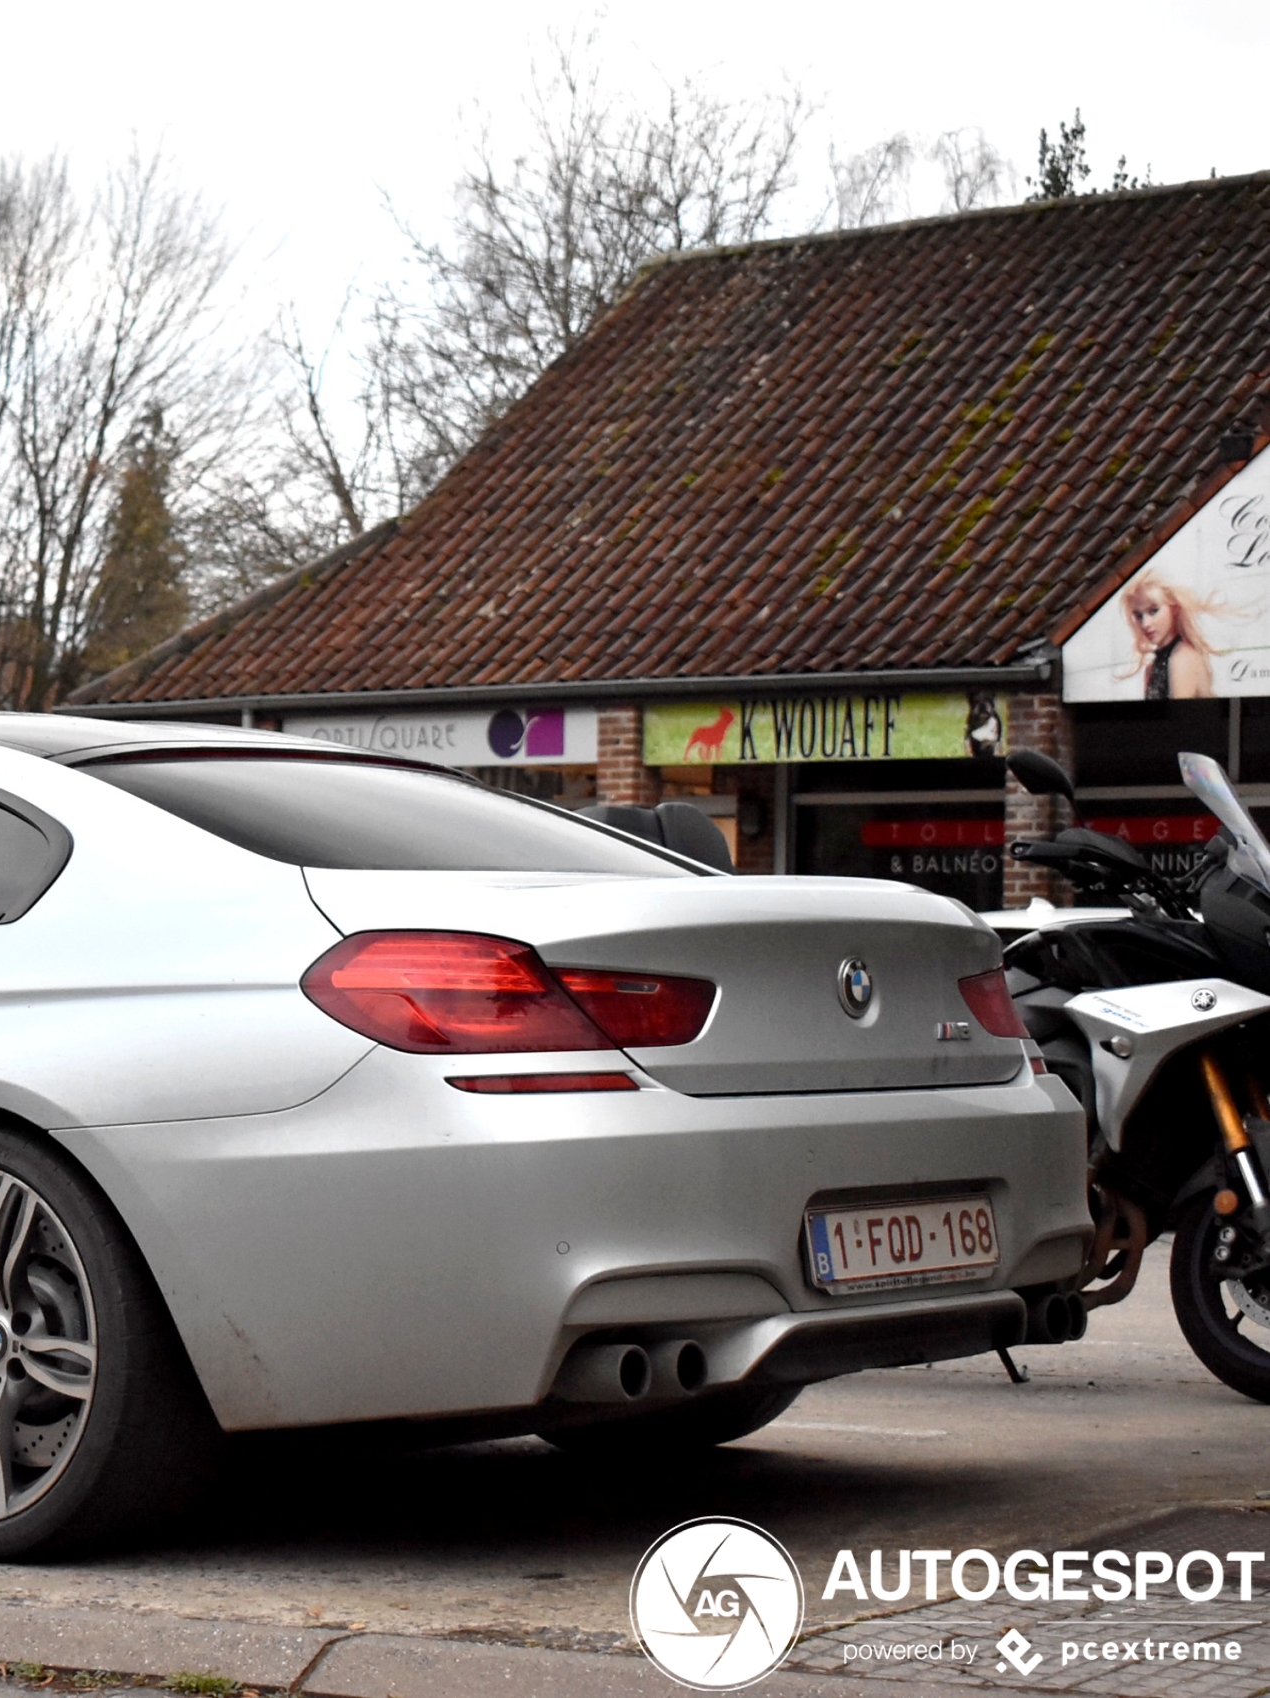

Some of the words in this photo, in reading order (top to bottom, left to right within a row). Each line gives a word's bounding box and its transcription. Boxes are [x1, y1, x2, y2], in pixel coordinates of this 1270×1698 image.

[1219, 495, 1270, 533] Co
[739, 695, 901, 760] K'WOUAFF
[891, 856, 904, 873] &
[913, 851, 1004, 873] BALNÉO
[817, 1252, 830, 1275] B
